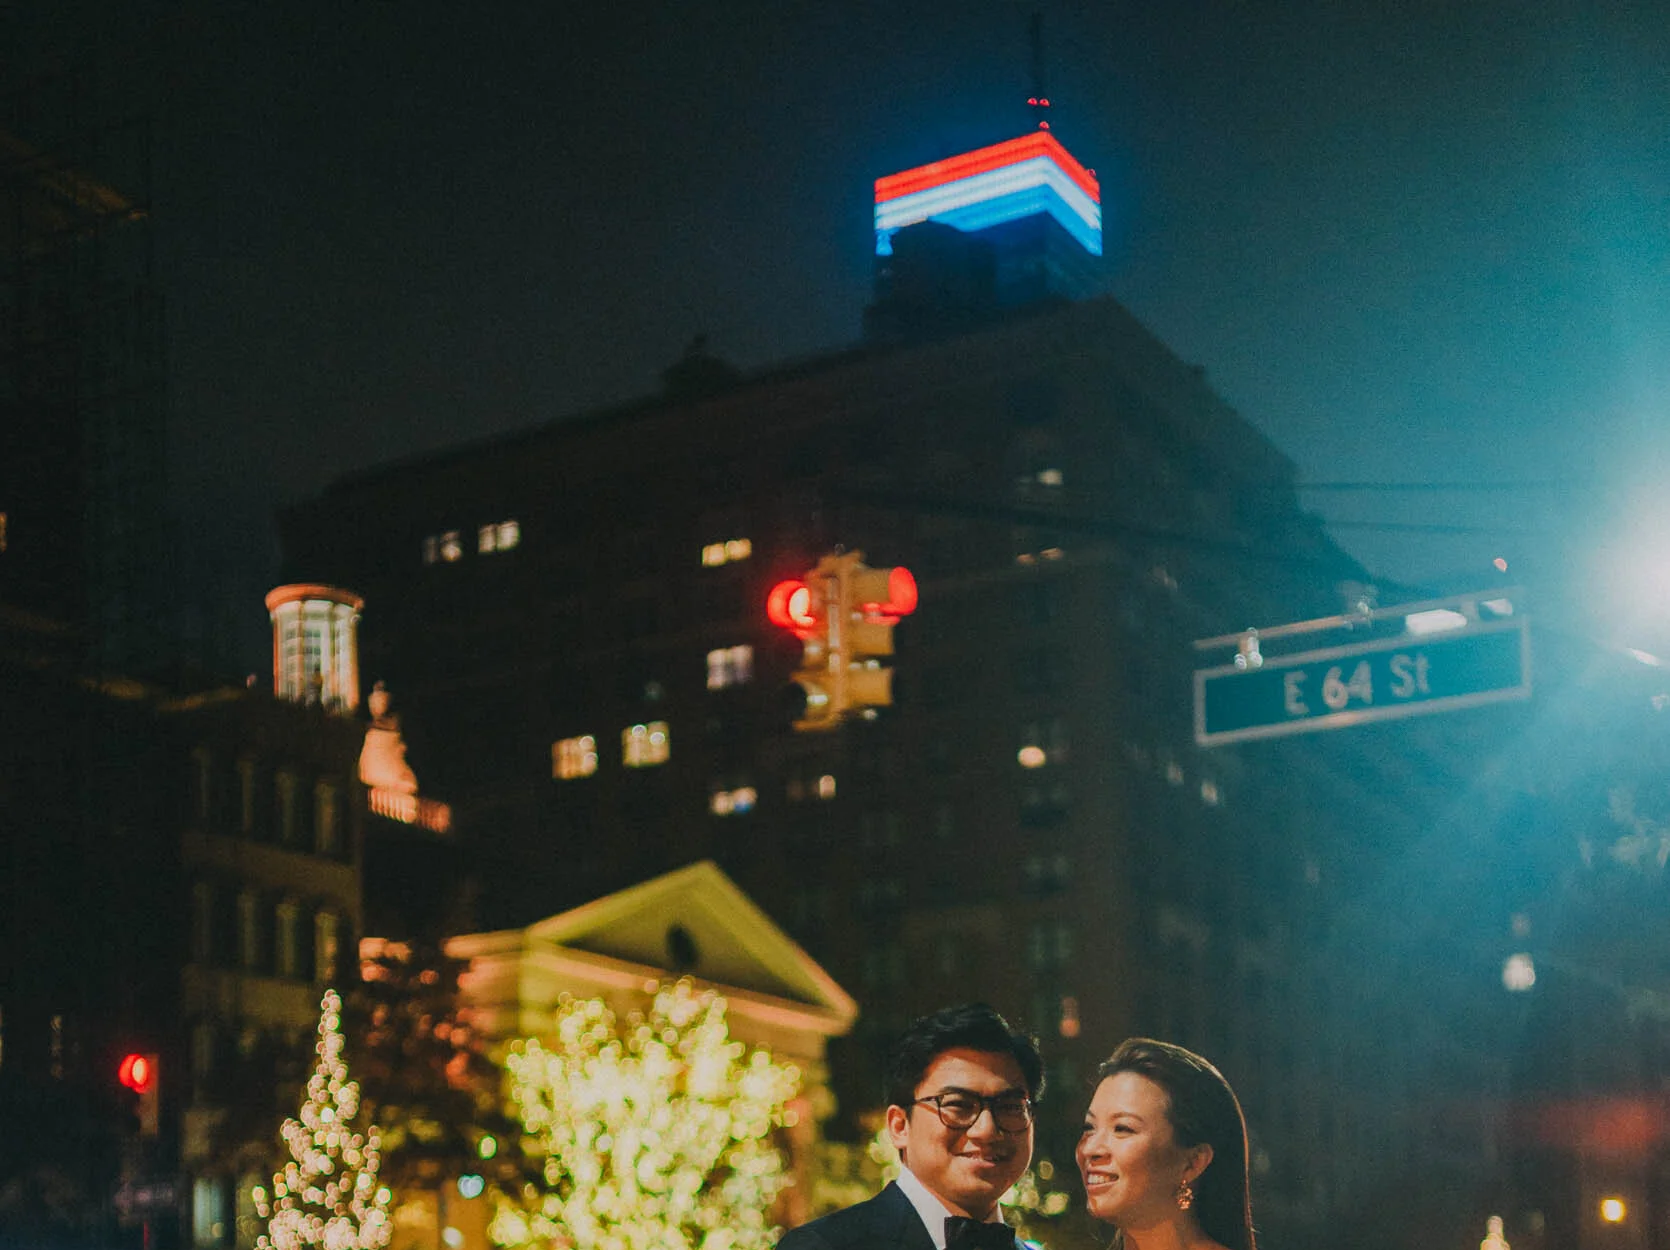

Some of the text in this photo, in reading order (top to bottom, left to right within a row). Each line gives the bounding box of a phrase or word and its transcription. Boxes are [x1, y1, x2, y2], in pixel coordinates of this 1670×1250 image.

[1285, 654, 1431, 715] E 64 St
